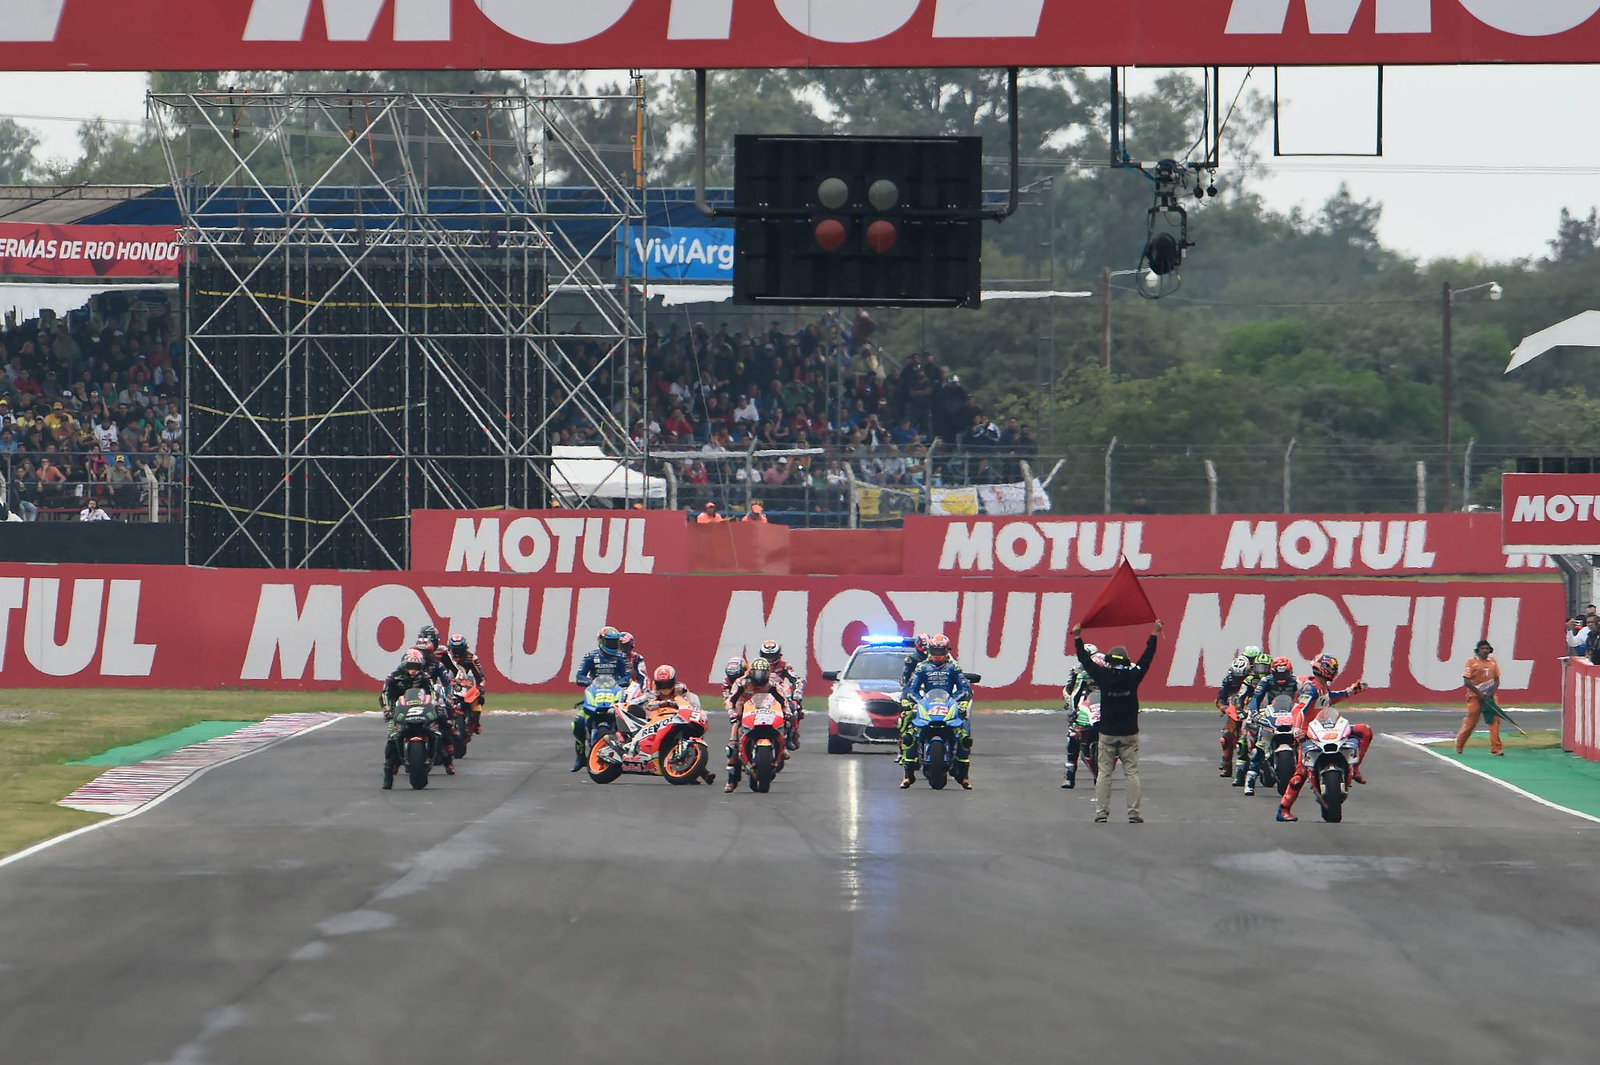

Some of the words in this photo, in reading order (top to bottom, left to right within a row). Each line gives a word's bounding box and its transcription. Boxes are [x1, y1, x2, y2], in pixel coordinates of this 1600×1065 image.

[59, 240, 83, 260] DE
[117, 242, 180, 261] HONDO
[1511, 494, 1600, 522] MOT
[446, 517, 654, 574] MOTUL
[939, 521, 1152, 572] MOTUL
[1221, 520, 1436, 570] MOTUL
[240, 583, 611, 685] MOTUL
[709, 589, 1081, 689] MOTUL
[1167, 593, 1534, 692] MOTUL
